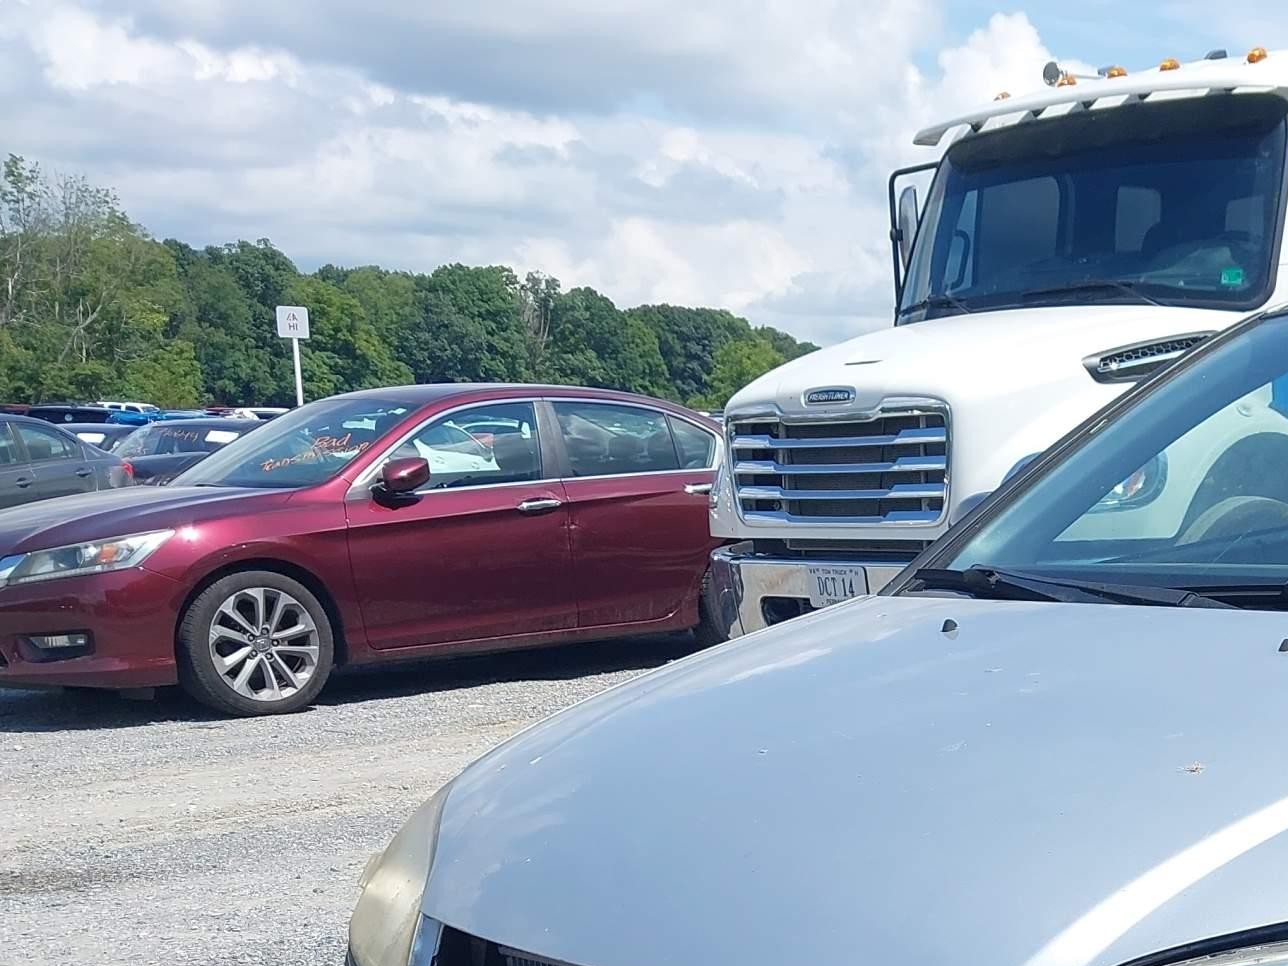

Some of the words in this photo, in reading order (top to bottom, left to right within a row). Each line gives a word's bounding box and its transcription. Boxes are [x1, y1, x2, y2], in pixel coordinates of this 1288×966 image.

[312, 433, 352, 449] Bad
[817, 576, 837, 597] DCT
[841, 577, 855, 597] 14
